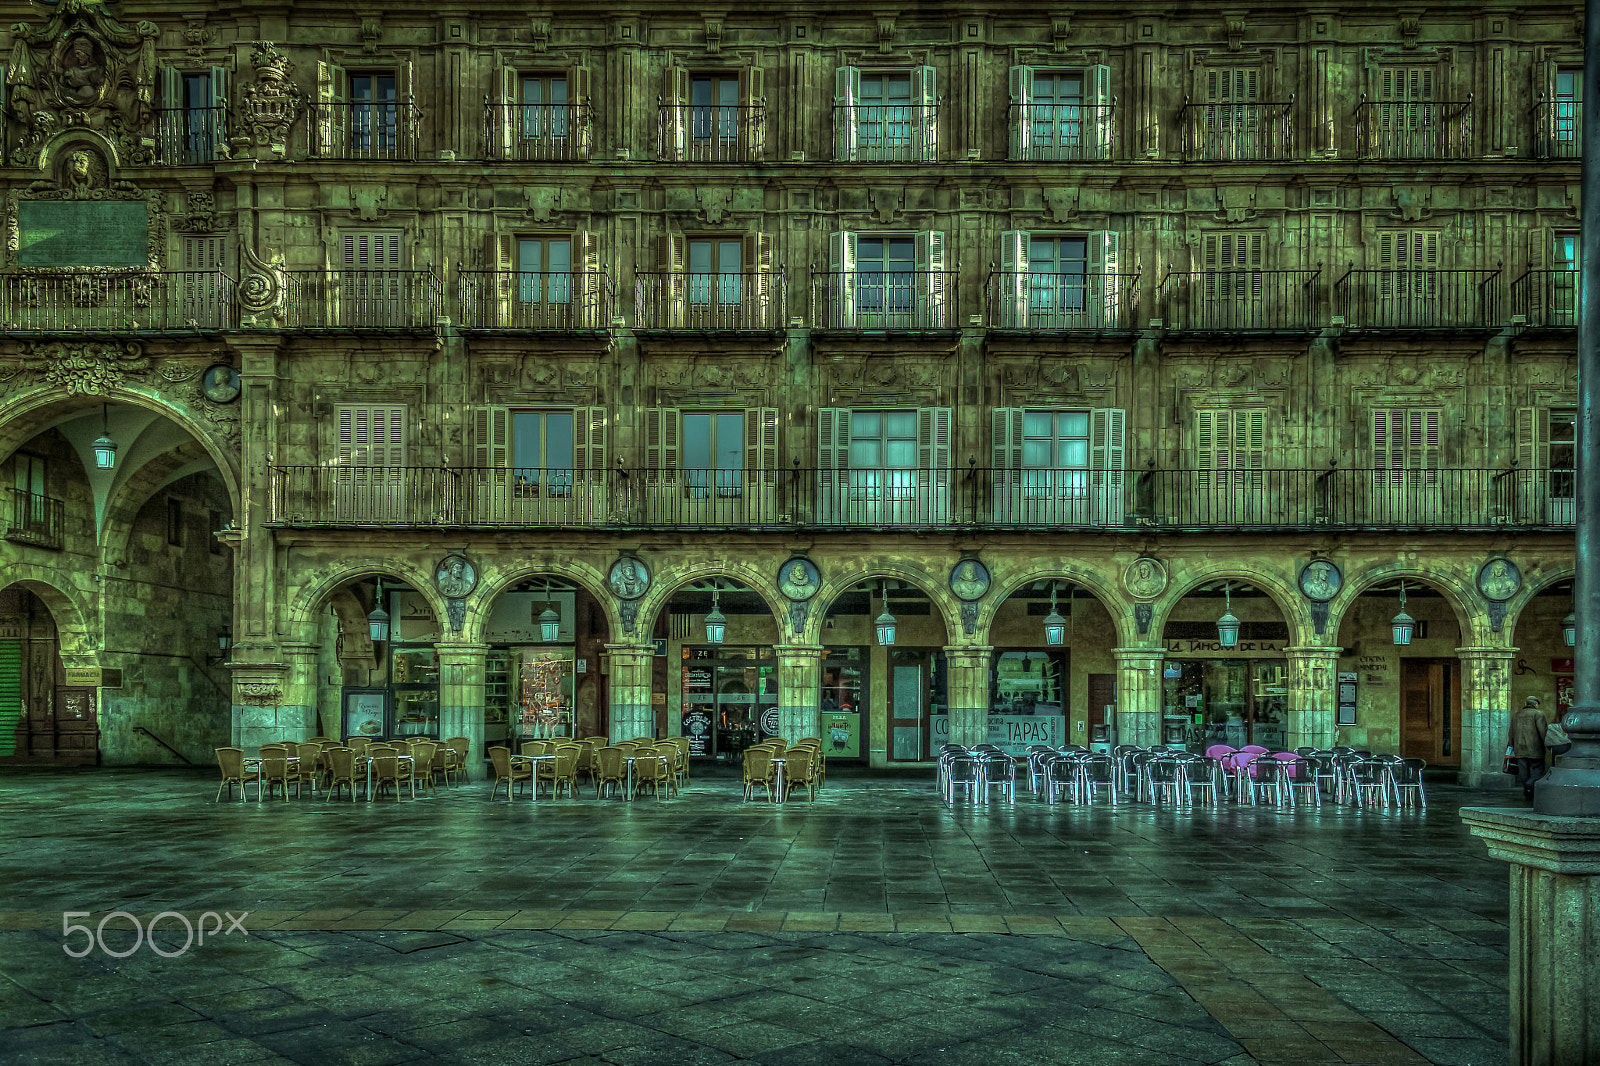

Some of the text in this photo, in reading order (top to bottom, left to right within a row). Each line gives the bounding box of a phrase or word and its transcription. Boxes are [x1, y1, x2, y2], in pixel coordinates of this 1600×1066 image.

[1240, 642, 1257, 651] DE
[1260, 642, 1276, 651] LA
[935, 718, 949, 735] CO
[1007, 722, 1048, 741] TAPAS
